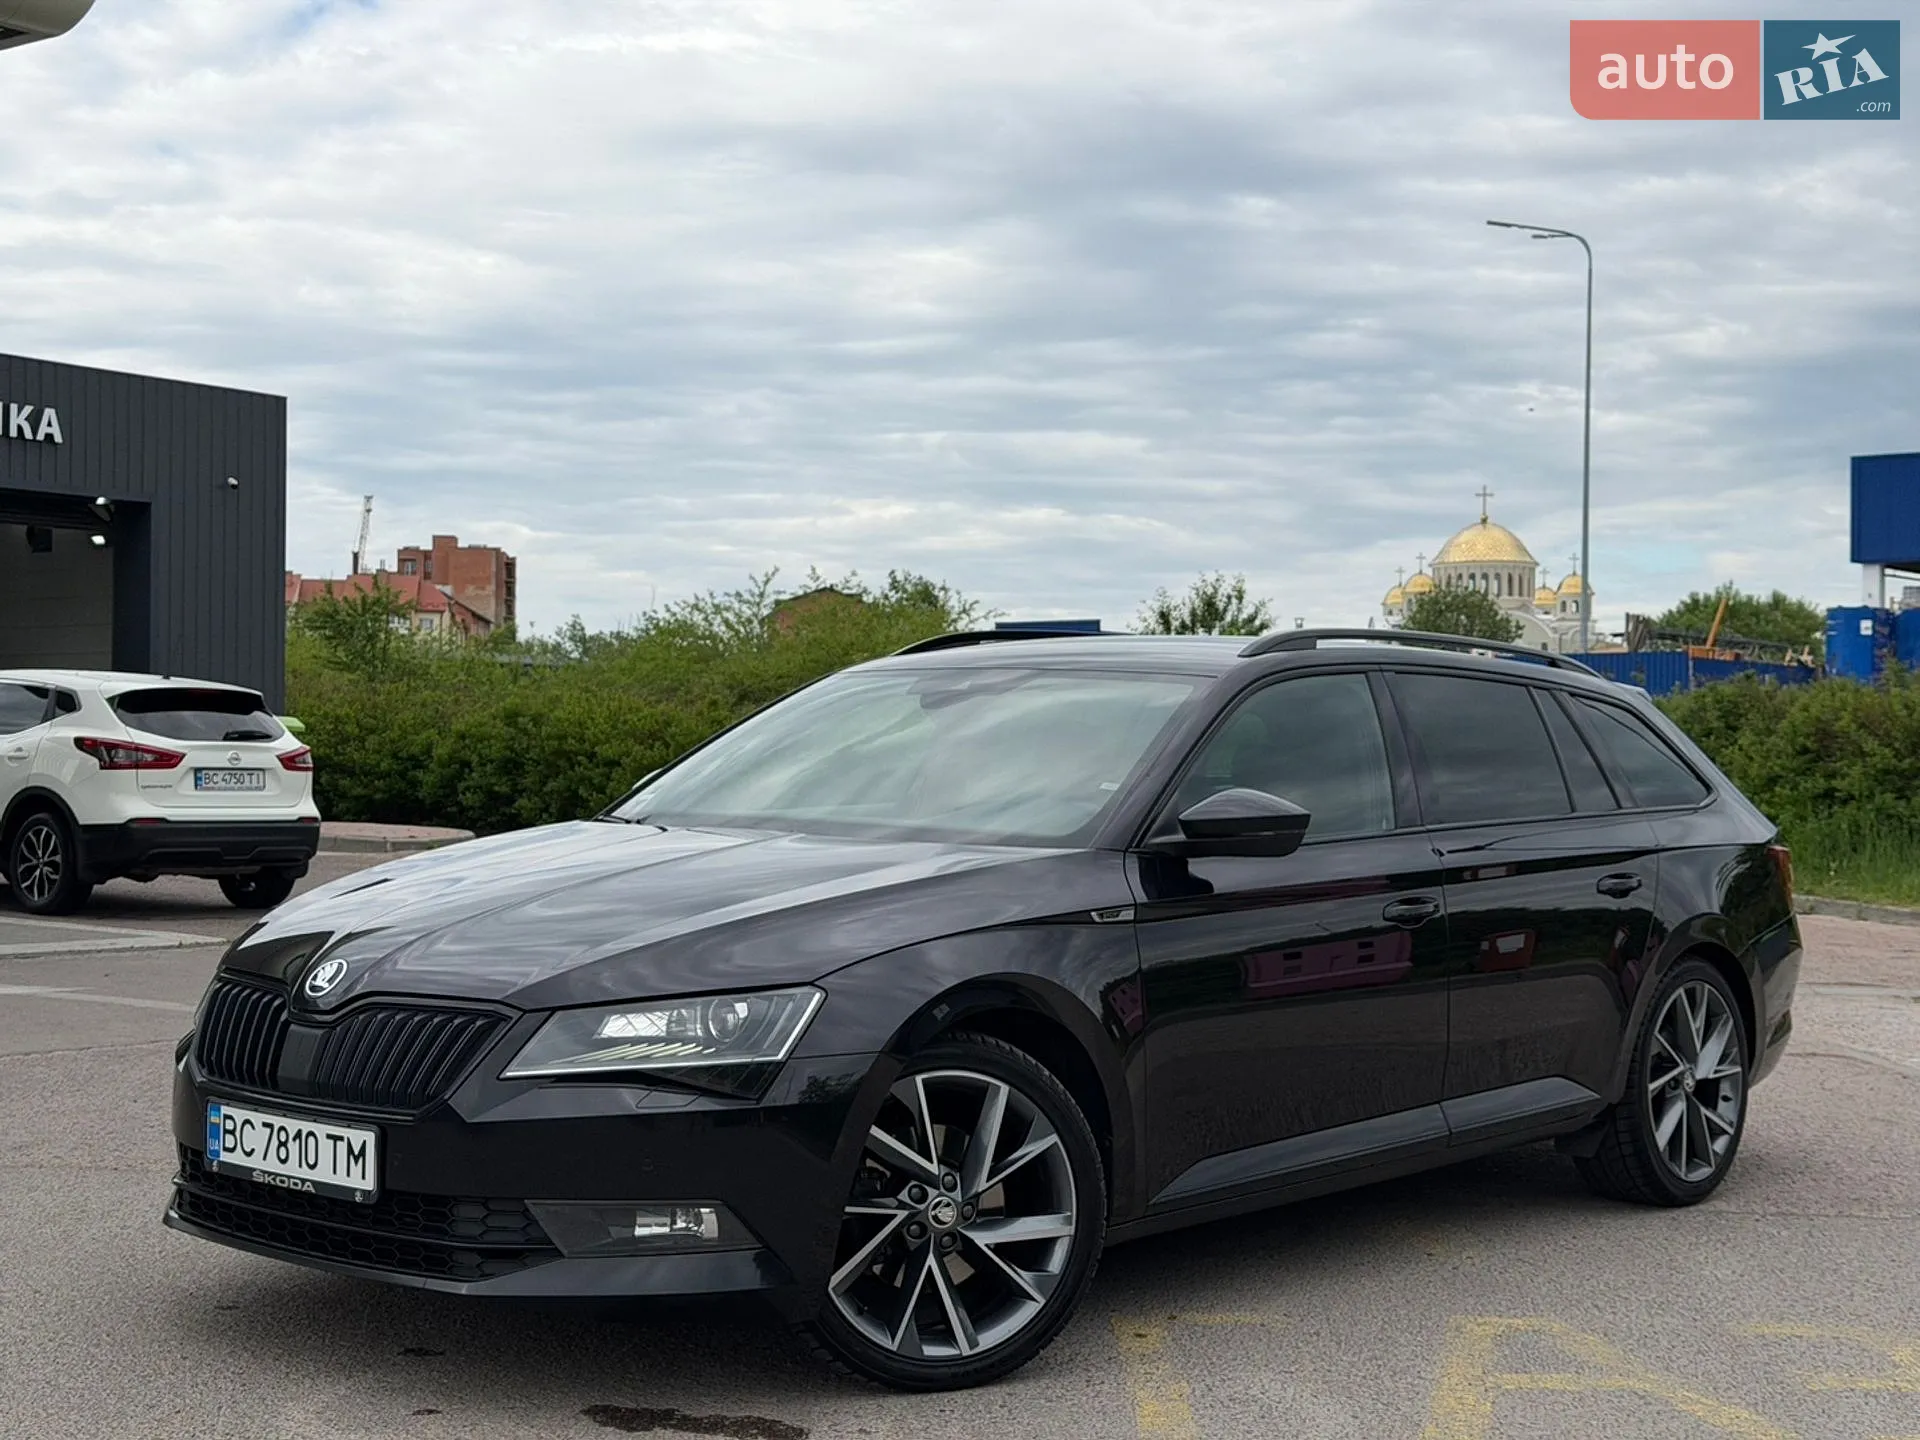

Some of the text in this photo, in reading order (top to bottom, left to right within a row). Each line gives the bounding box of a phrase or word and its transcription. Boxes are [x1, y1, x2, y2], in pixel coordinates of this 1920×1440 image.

[203, 772, 219, 785] BC
[221, 772, 245, 785] 4750
[222, 1113, 367, 1181] BC 7810 TM
